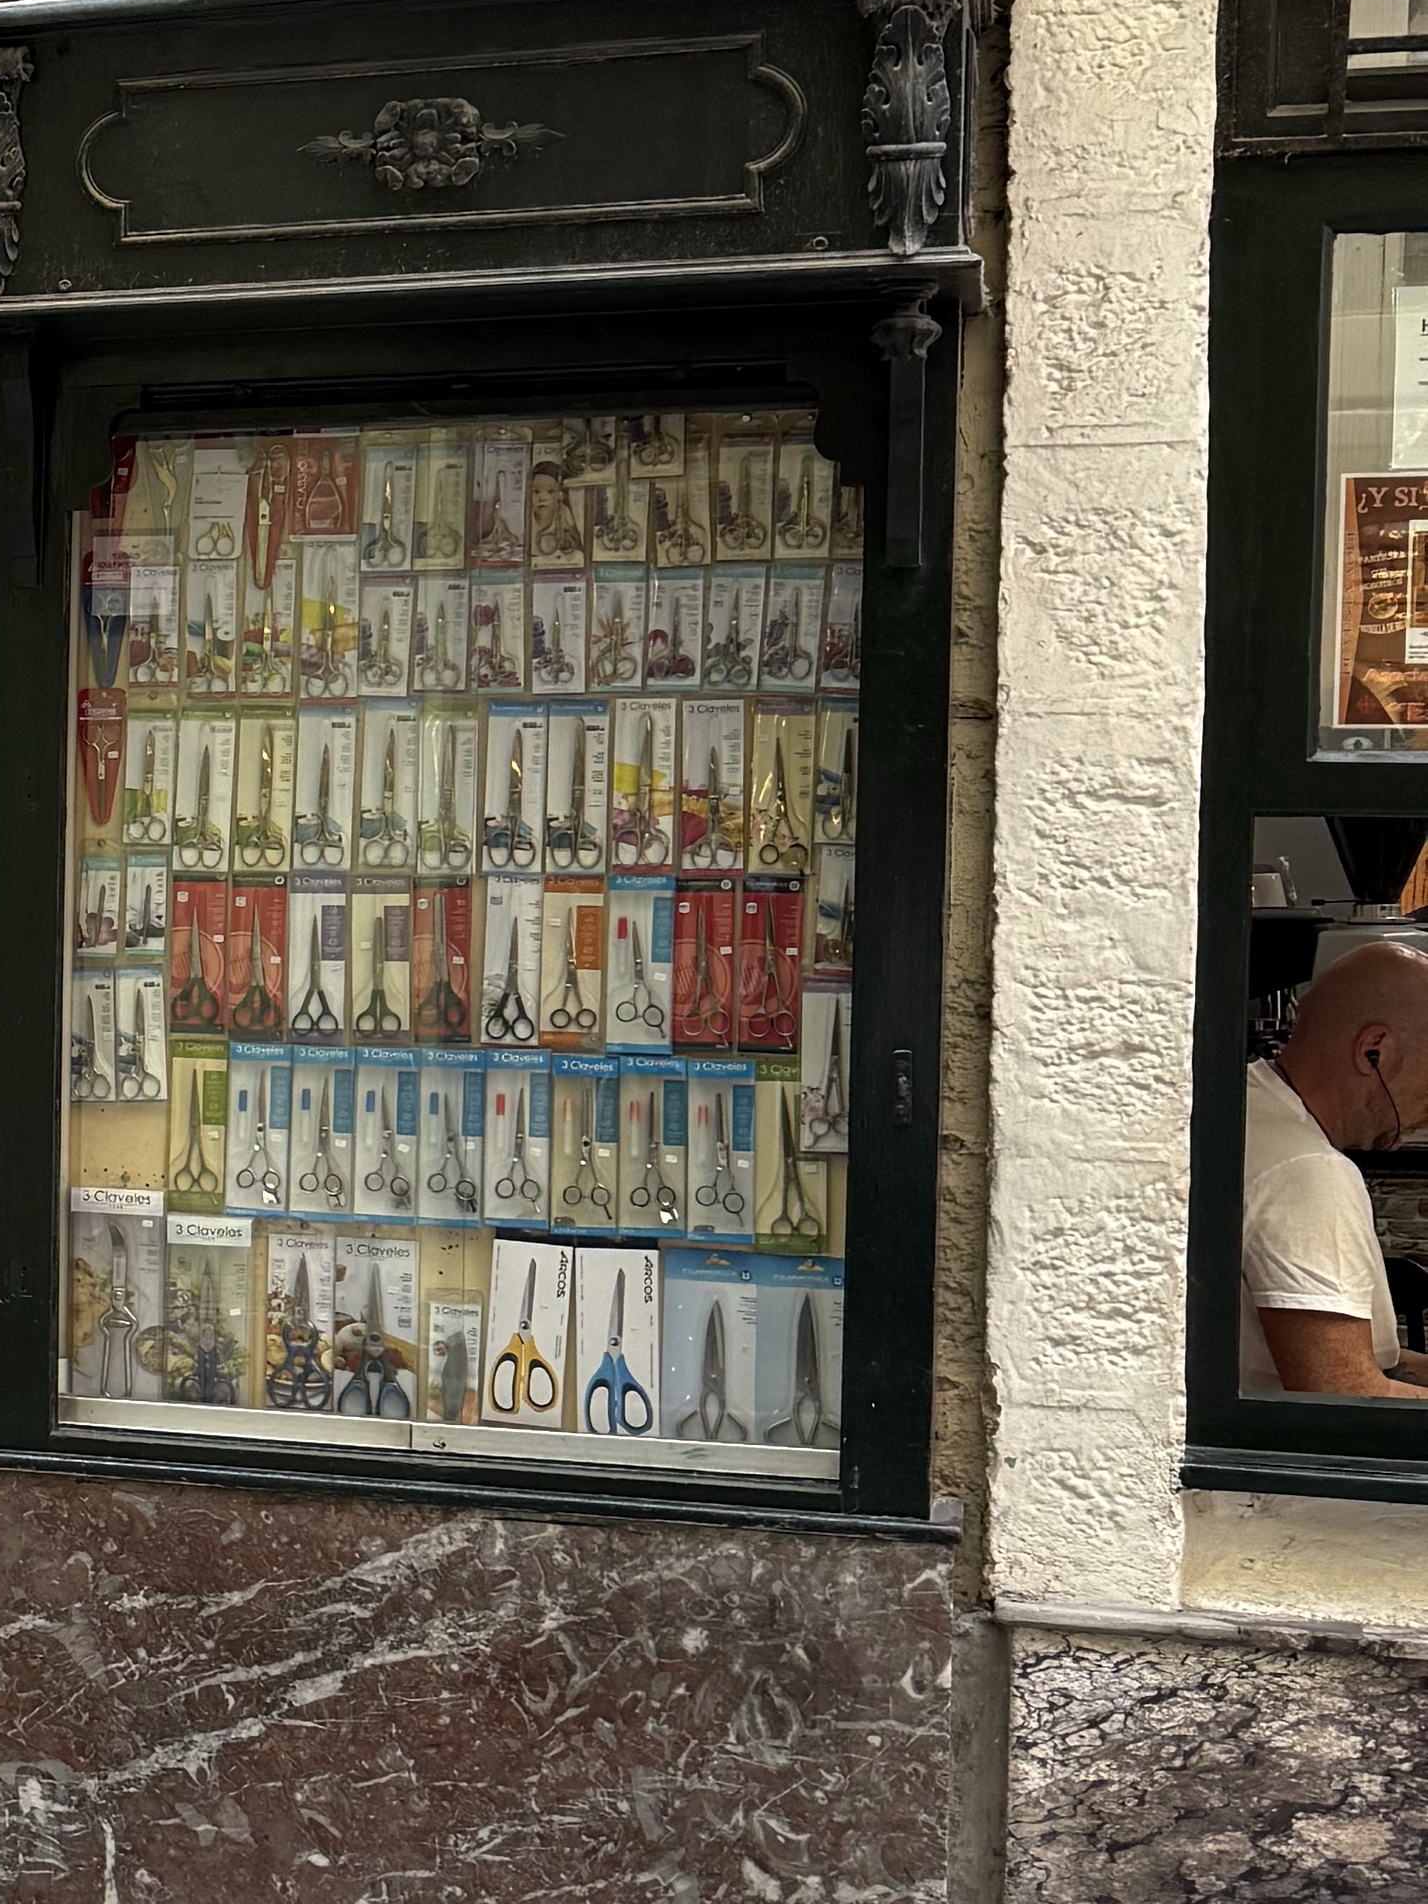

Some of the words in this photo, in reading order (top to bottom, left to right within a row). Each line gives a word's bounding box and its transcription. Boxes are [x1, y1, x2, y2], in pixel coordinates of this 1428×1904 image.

[83, 1190, 90, 1202] 3
[93, 1190, 151, 1206] Claveles
[175, 1223, 184, 1235] 3
[186, 1223, 244, 1238] Claveles
[346, 1243, 354, 1255] 3
[557, 1250, 569, 1298] ARCOS
[644, 1255, 654, 1303] ARCOS
